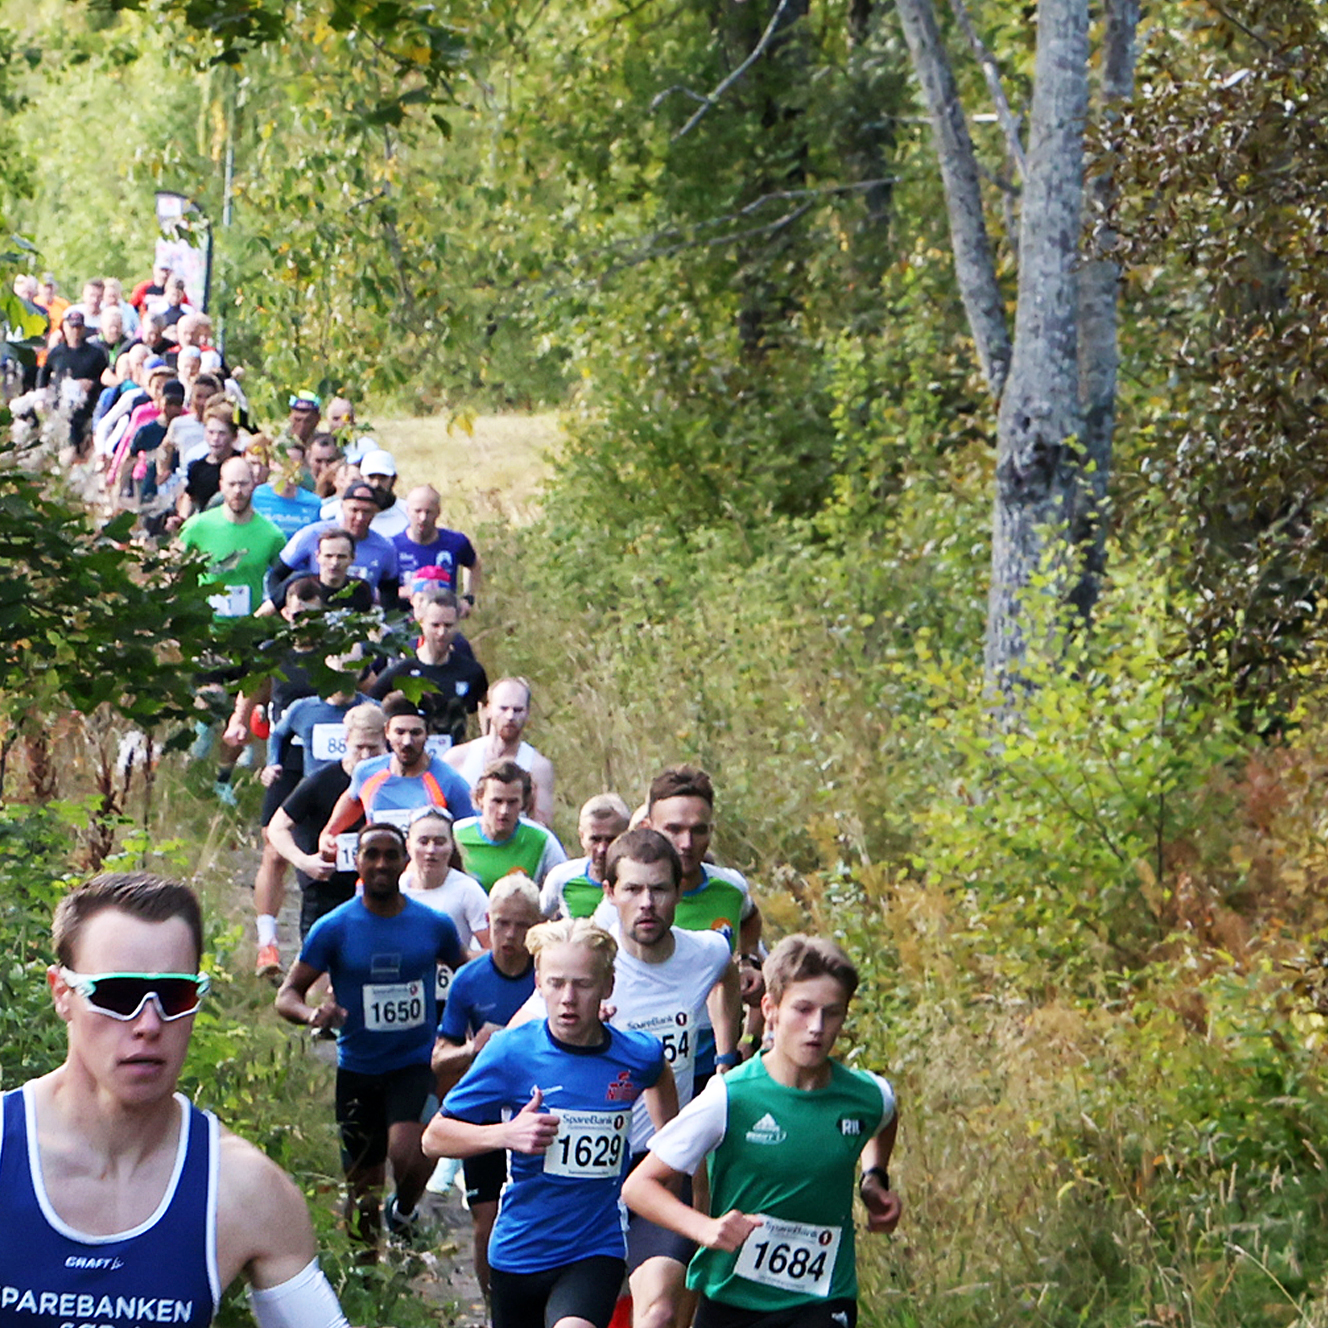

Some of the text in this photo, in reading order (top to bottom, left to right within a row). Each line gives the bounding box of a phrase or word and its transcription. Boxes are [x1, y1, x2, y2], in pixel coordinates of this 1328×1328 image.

[371, 998, 421, 1023] 1650
[558, 1134, 621, 1167] 1629
[754, 1241, 827, 1282] 1684
